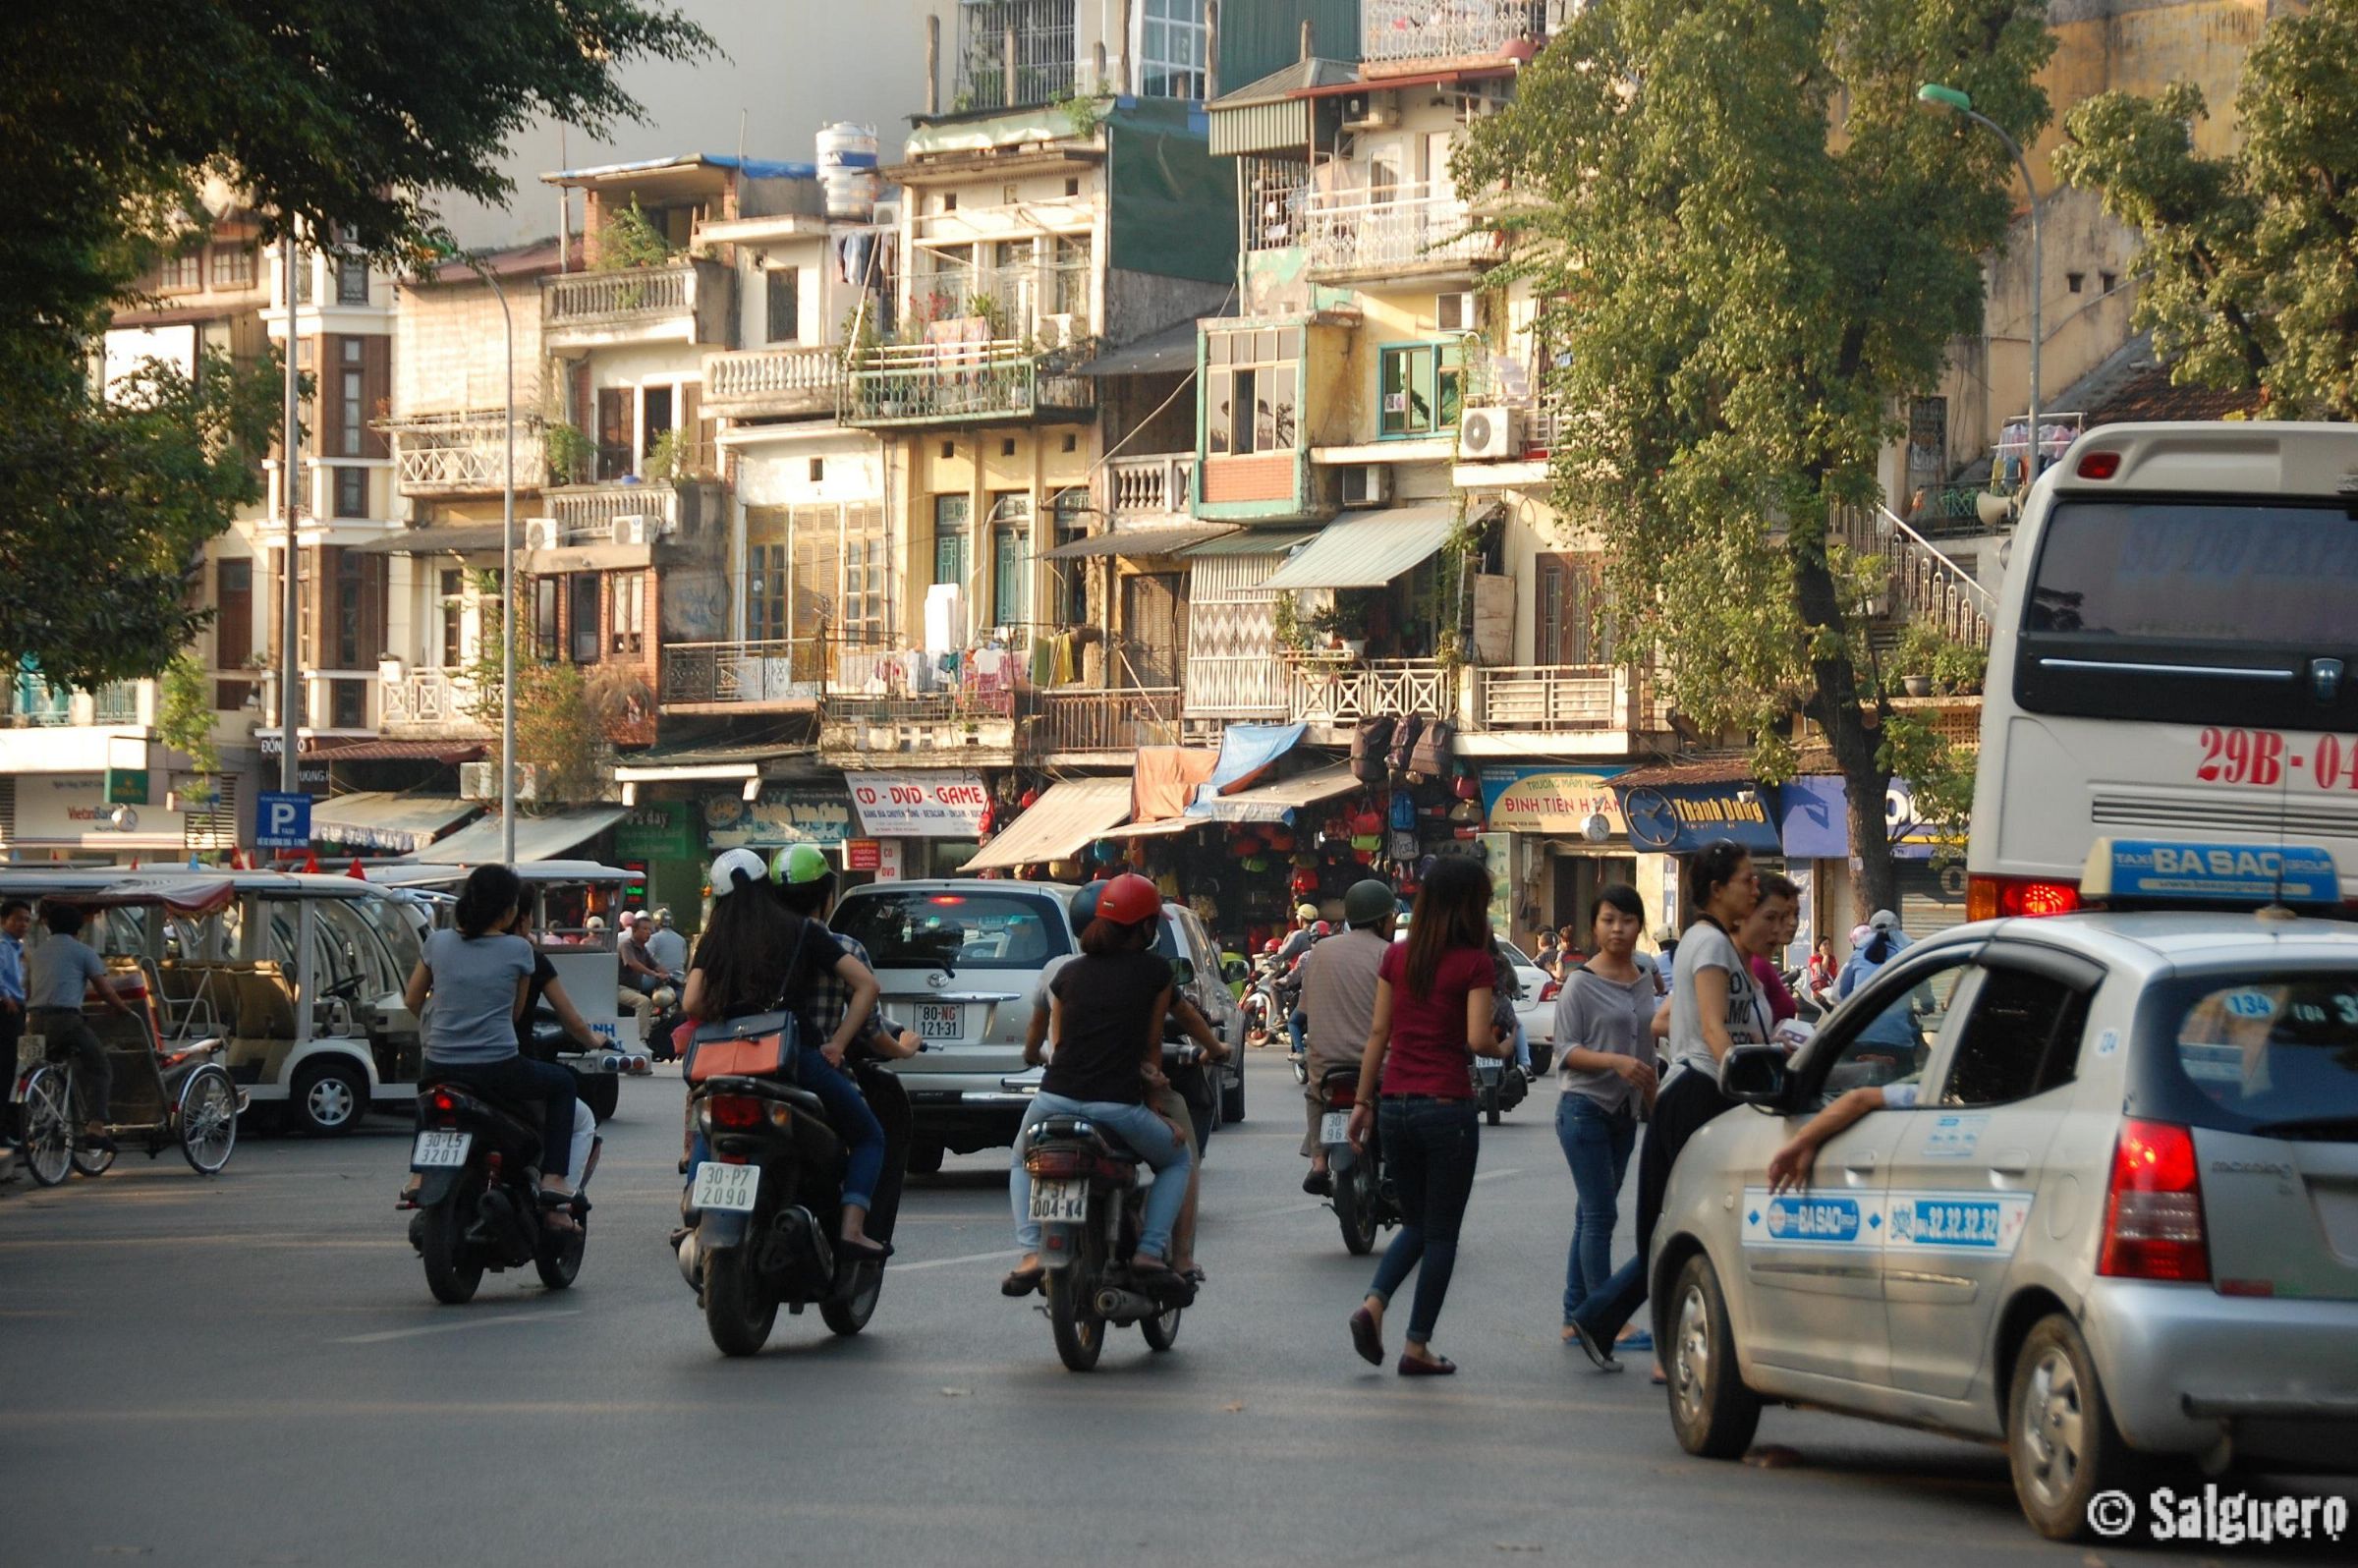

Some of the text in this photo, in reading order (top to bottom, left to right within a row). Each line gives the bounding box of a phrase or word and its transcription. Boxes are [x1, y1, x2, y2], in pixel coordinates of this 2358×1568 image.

[856, 787, 877, 805] CD
[889, 787, 923, 805] DVD
[936, 787, 983, 805] GAME
[1504, 797, 1541, 813] ĐINH
[1543, 793, 1574, 813] TIÊN
[271, 802, 296, 834] P
[1673, 797, 1724, 822] Thanh
[2153, 848, 2207, 874] BA
[2208, 850, 2286, 877] SAO
[923, 1006, 956, 1021] 80-NG
[2231, 994, 2272, 1015] 134
[2333, 993, 2358, 1024] 3
[921, 1022, 957, 1036] 121-31
[424, 1134, 464, 1148] 30-L5
[421, 1148, 459, 1163] 3201
[705, 1166, 751, 1186] 30-P7
[702, 1187, 747, 1206] 2090
